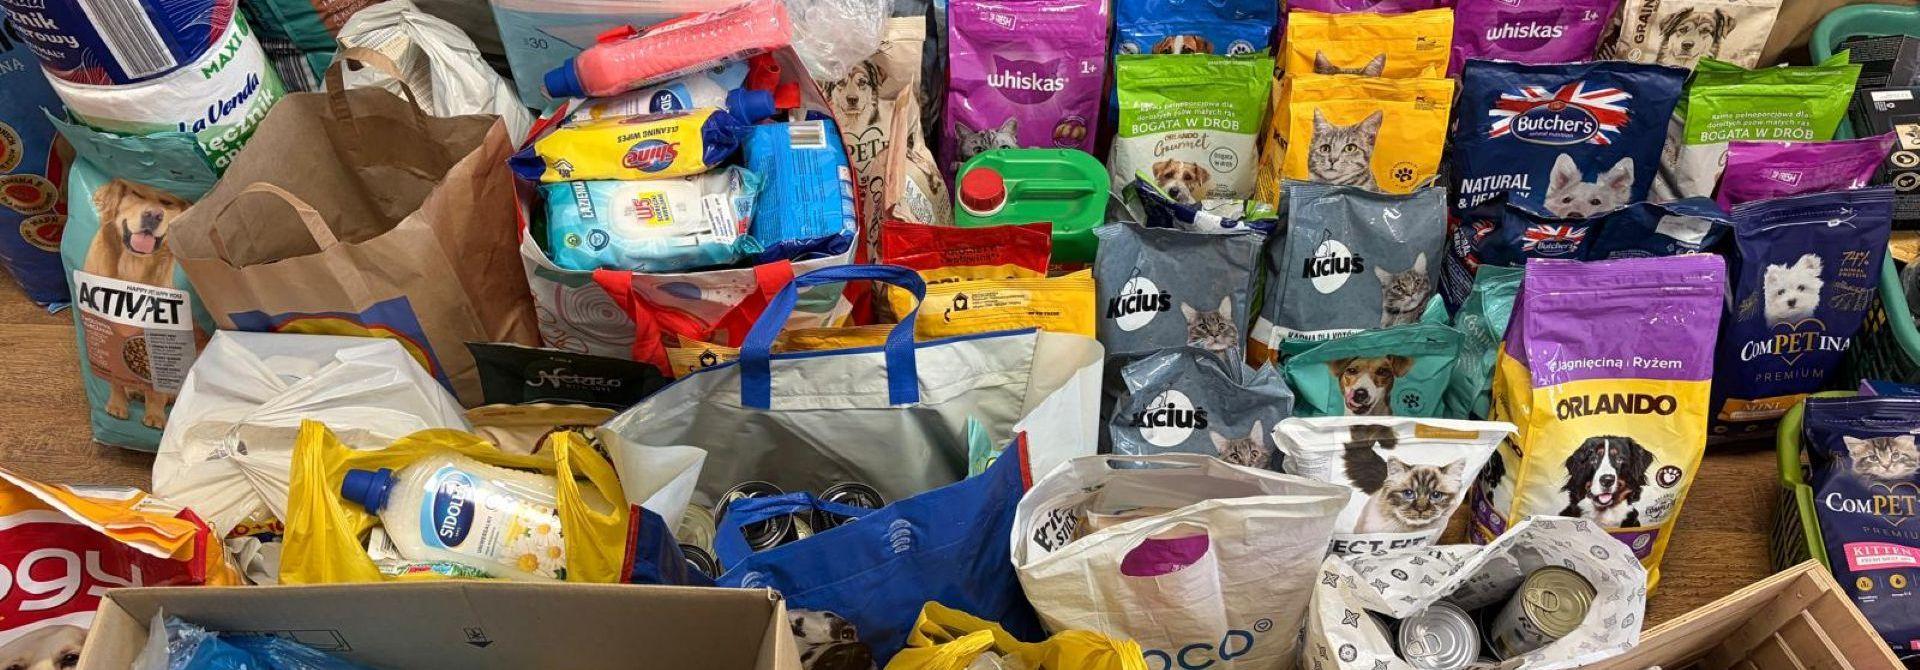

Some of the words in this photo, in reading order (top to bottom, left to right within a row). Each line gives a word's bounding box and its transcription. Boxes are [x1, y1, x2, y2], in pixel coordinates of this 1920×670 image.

[1582, 10, 1599, 22] 1+
[1486, 21, 1564, 41] whiskas
[201, 31, 243, 80] MAXI
[1080, 60, 1097, 75] 1+
[987, 69, 1065, 93] whiskas
[208, 72, 260, 125] Venda
[660, 93, 673, 114] SID
[643, 125, 680, 138] CLEANING
[1131, 119, 1182, 135] BOGATA
[1186, 118, 1198, 128] W
[1517, 113, 1593, 134] Butcher's
[617, 132, 642, 144] WIPES
[1700, 128, 1751, 142] BOGATA
[1755, 128, 1768, 139] W
[1773, 126, 1814, 140] DRÓB
[622, 142, 681, 169] Shine
[1460, 173, 1532, 194] NATURAL
[1458, 198, 1468, 210] &
[1632, 356, 1682, 370] Ryżem
[1755, 368, 1825, 383] PREMIUM
[1556, 393, 1677, 422] ORLANDO
[1825, 492, 1920, 516] COMPET
[1056, 508, 1078, 546] STICK
[1863, 526, 1920, 540] PREMIU
[1328, 539, 1384, 554] ECT
[1853, 545, 1912, 556] KITTEN
[0, 546, 144, 613] gy
